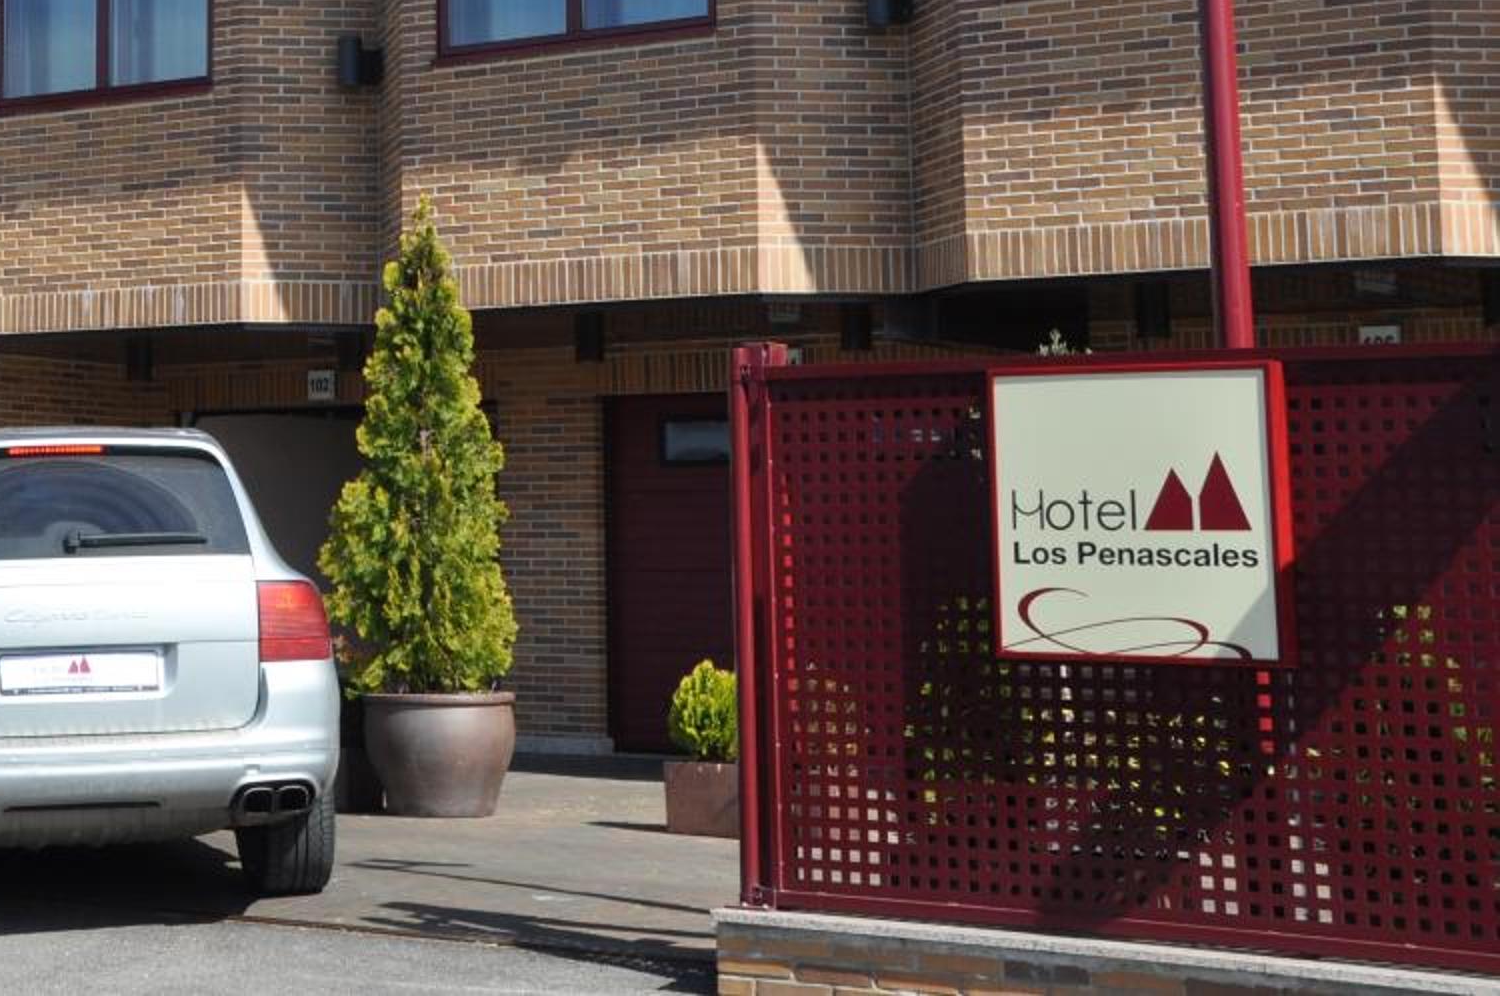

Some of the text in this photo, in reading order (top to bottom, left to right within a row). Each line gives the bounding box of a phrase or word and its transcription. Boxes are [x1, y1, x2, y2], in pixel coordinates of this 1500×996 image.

[1011, 490, 1137, 530] Hotel
[1013, 542, 1259, 567] Los Penascales
